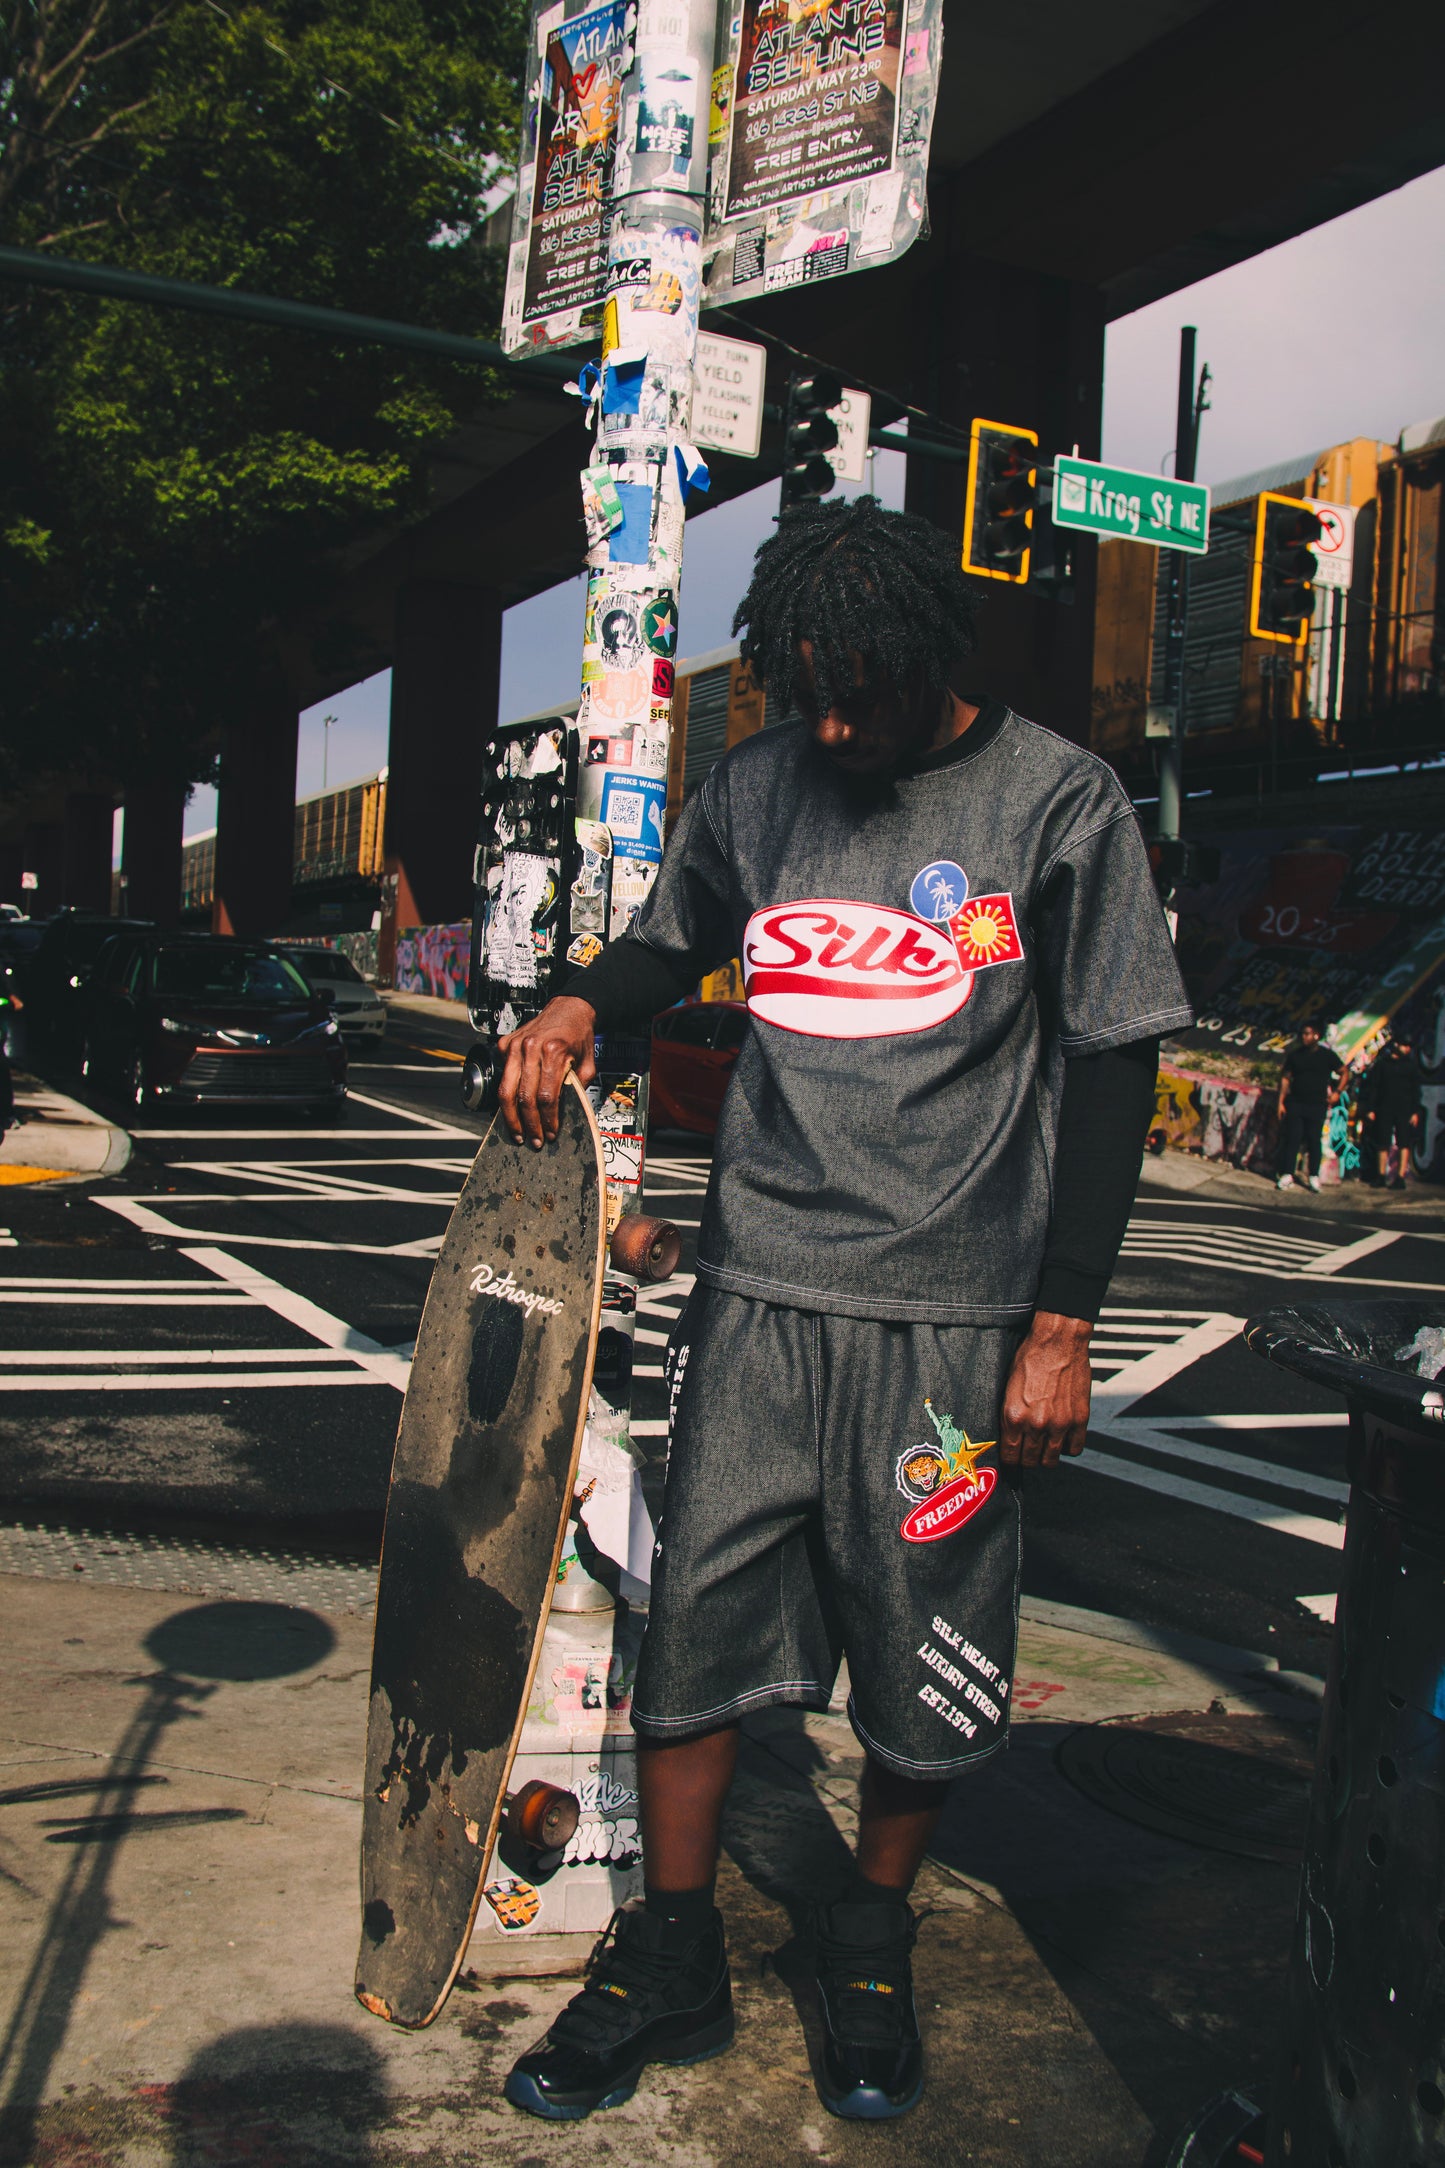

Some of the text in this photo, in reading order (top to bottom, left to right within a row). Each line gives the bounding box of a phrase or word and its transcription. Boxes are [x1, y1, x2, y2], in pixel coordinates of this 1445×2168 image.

[753, 0, 887, 63] ATLANTA
[748, 22, 886, 95] BELTLINE
[747, 59, 882, 117] SATURDAY MAY 23RD
[745, 120, 770, 145] 116
[772, 99, 819, 134] KROG
[823, 89, 846, 115] ST
[850, 80, 880, 107] NE
[641, 125, 690, 145] WAGE
[646, 138, 683, 155] 123
[754, 146, 802, 175] FREE
[807, 128, 863, 158] ENTRY
[781, 176, 816, 196] ARTISTS
[826, 155, 888, 182] COMMUNITY
[541, 202, 597, 233] SATURDAY
[546, 260, 586, 285] FREE
[764, 272, 804, 293] DREAM
[765, 256, 805, 282] FREE
[567, 287, 595, 305] ARTISTS
[696, 343, 750, 364] LEFT TURN
[703, 363, 743, 384] YIELD
[708, 386, 753, 406] FLASHING
[702, 405, 739, 421] YELLOW
[698, 424, 735, 440] ARROW
[1089, 478, 1201, 536] Krog St NE
[610, 776, 638, 787] JERKS
[612, 881, 644, 898] YELLOW
[1258, 905, 1301, 938] 20
[747, 911, 958, 978] Silk
[469, 1264, 565, 1319] Retrospec
[915, 1472, 986, 1536] FREEDOM
[931, 1614, 963, 1651] SILK
[960, 1640, 1000, 1682] HEART
[916, 1641, 1002, 1725] LUXURY STREET
[917, 1683, 977, 1741] EST.1974
